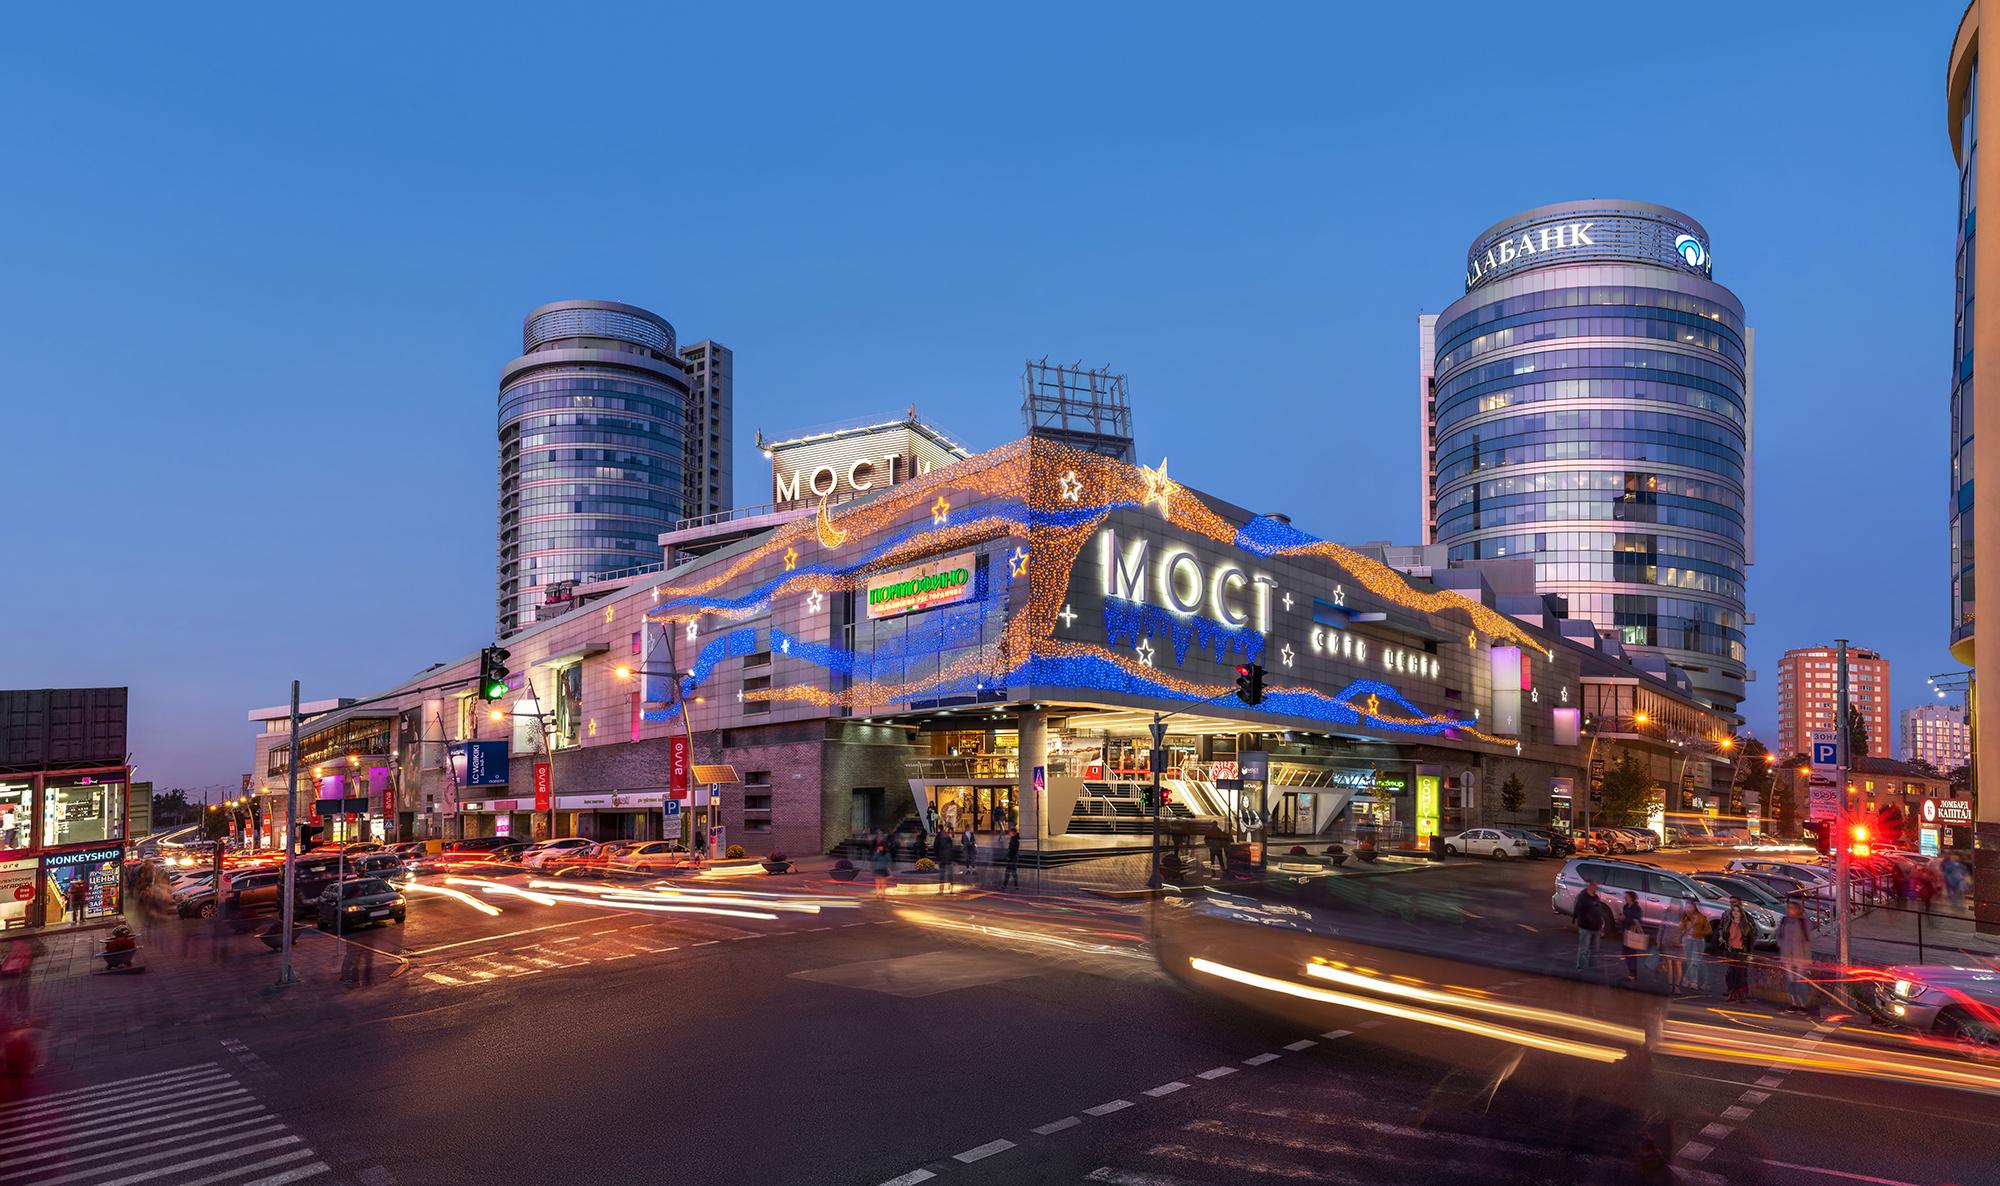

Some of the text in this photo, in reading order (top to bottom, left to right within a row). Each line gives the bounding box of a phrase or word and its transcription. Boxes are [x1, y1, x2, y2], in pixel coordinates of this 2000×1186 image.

[776, 453, 902, 503] МОСТ
[869, 568, 969, 605] ПОРТОФИНО
[1103, 528, 1279, 635] МОСТ
[1311, 628, 1441, 679] СИТИ ЦЕНТР
[1820, 745, 1834, 762] P
[472, 773, 480, 784] LC
[1422, 778, 1431, 818] COMFY
[1940, 800, 1969, 809] ЛОМБАРД
[667, 801, 677, 814] P
[46, 850, 120, 866] MONKEYSHOP
[89, 875, 115, 884] ЦЕНЫ
